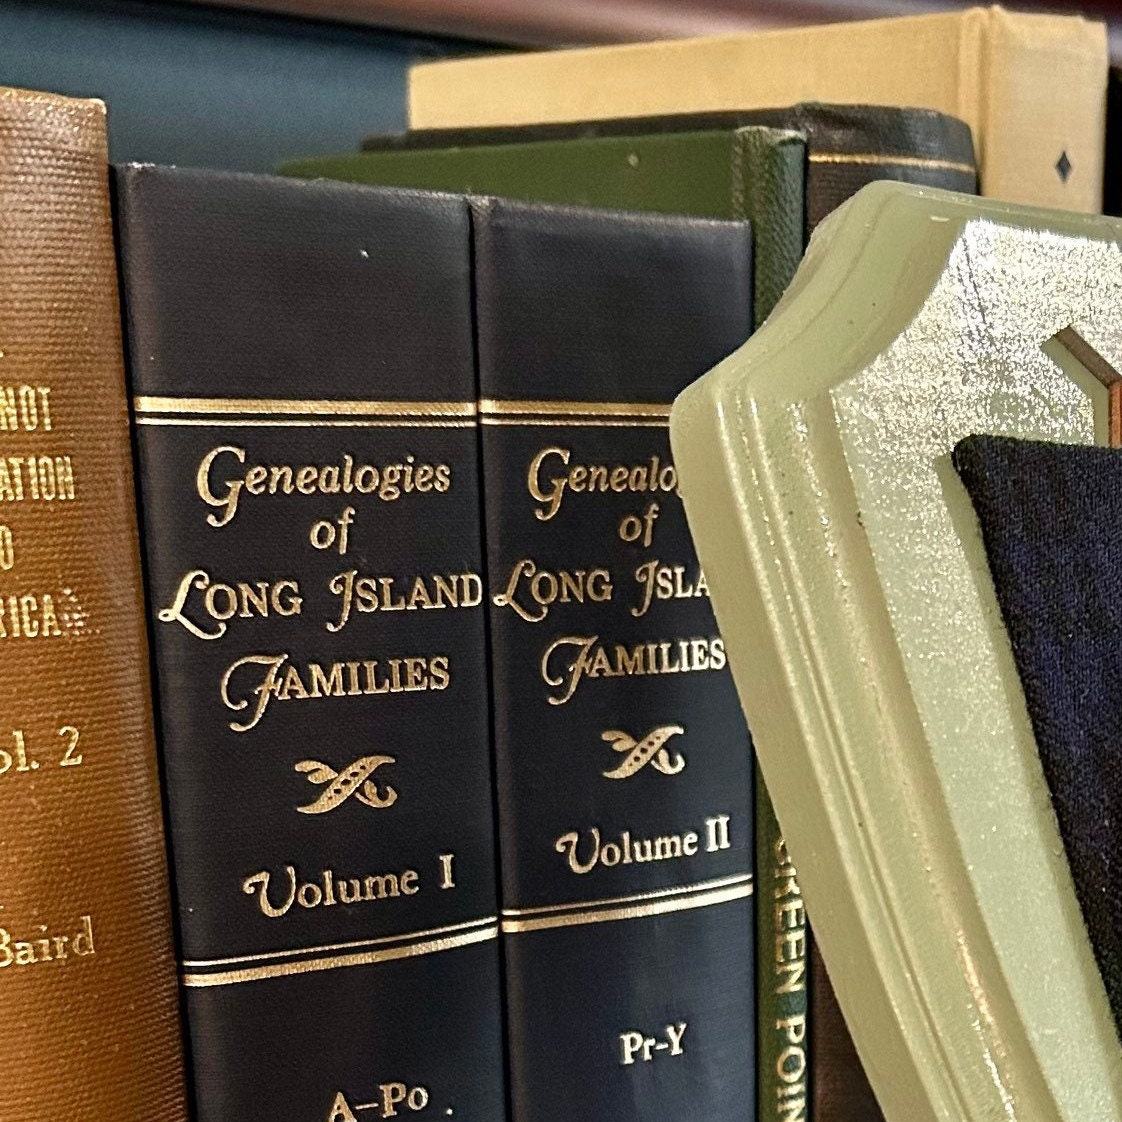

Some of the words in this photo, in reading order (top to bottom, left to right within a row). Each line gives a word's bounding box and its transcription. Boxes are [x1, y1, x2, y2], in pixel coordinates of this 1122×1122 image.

[196, 445, 450, 528] Genealogies
[527, 446, 684, 521] Genealo
[309, 506, 356, 555] of
[618, 502, 660, 548] of
[58, 725, 83, 767] 2
[555, 826, 698, 875] Volume
[704, 815, 732, 853] II
[243, 865, 420, 918] Volume
[438, 853, 457, 890] I
[619, 1021, 687, 1066] Pr-Y
